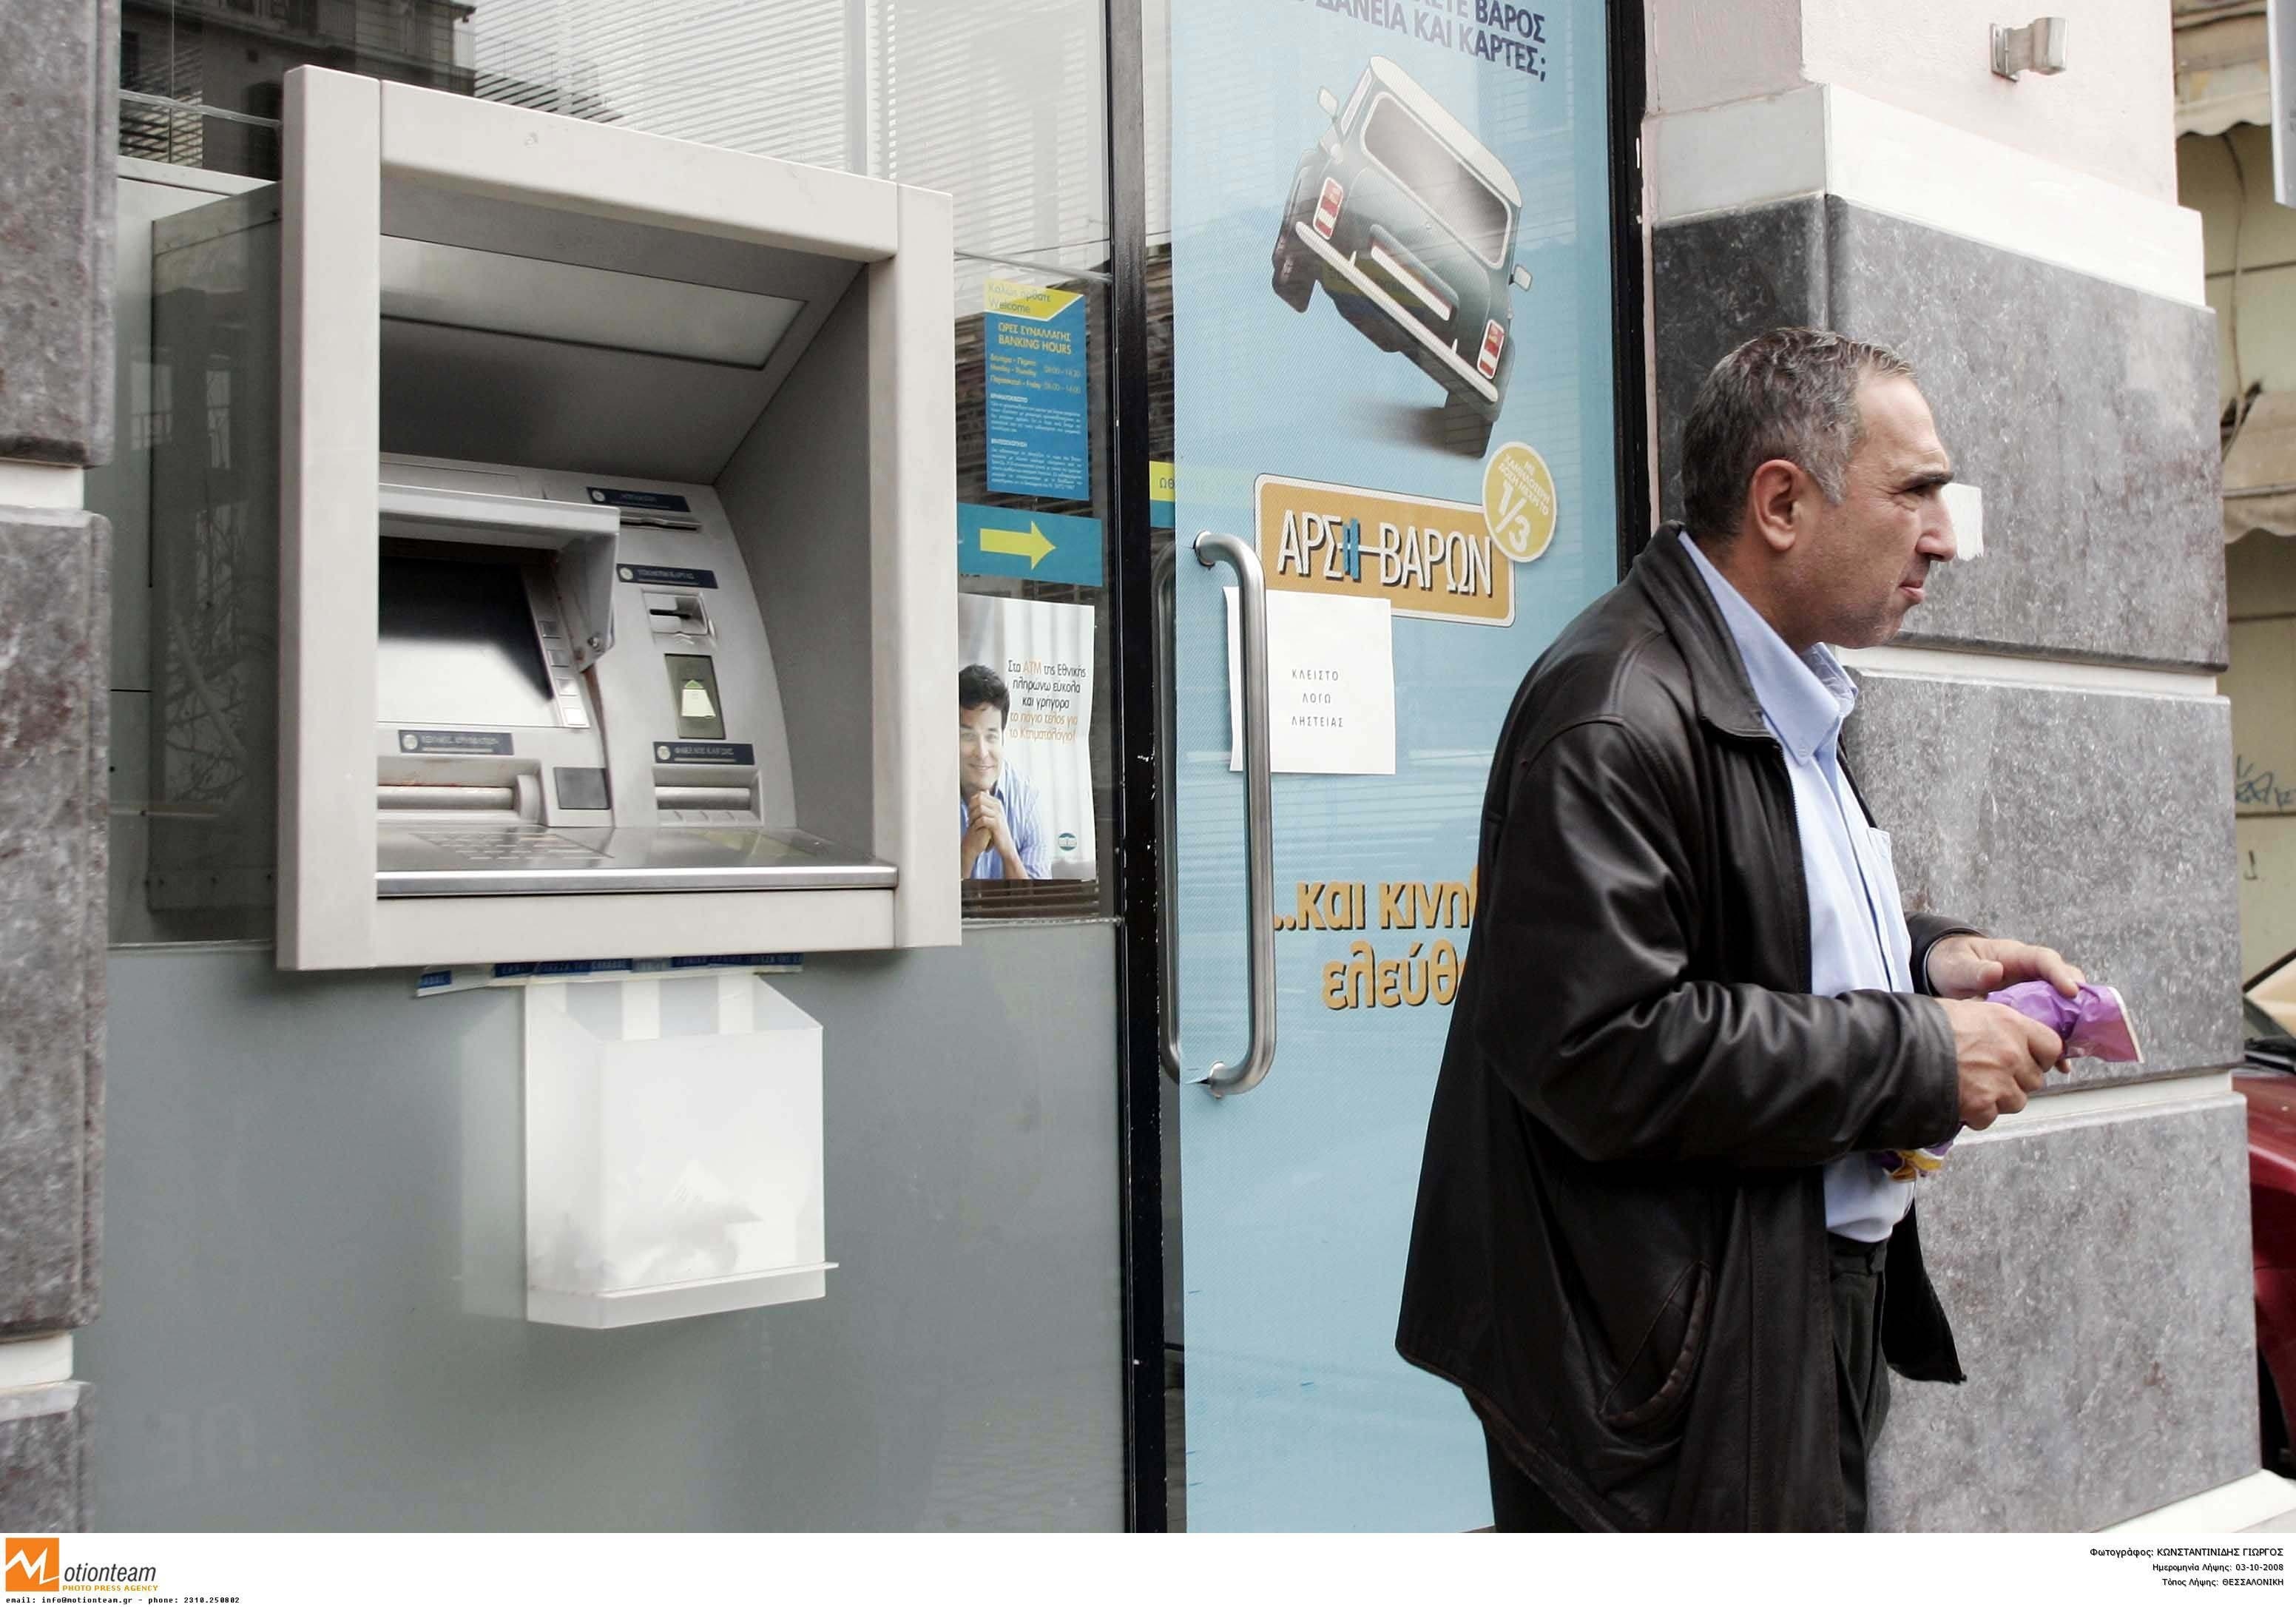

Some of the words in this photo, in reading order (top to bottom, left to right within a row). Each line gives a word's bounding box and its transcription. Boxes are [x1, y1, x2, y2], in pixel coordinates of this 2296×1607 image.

[1475, 0, 1545, 44] ΒΑΡΟΣ
[1414, 9, 1452, 48] ΚΑΙ
[1459, 23, 1546, 81] ΚΑΡΤΕΣ;
[988, 295, 1031, 313] Welcome
[999, 334, 1040, 350] BANKING
[1041, 340, 1072, 355] HOURS
[1494, 479, 1531, 553] 1/3
[1380, 522, 1493, 598] ΒΑΡΩΝ
[1007, 659, 1022, 673] Στα
[1044, 665, 1056, 676] της
[1292, 669, 1339, 681] ΚΛΕΙΣΤΟ
[1022, 697, 1034, 707] και
[1036, 695, 1070, 711] γρήγορα
[1302, 693, 1331, 704] ΛΟΓΩ
[1010, 712, 1018, 722] το
[1066, 715, 1078, 729] για
[1292, 715, 1343, 728] ΛΗΣΤΕΙΑΣ
[1010, 727, 1018, 738] το
[1379, 863, 1478, 930] κινη
[1322, 938, 1468, 1010] ελεύθ
